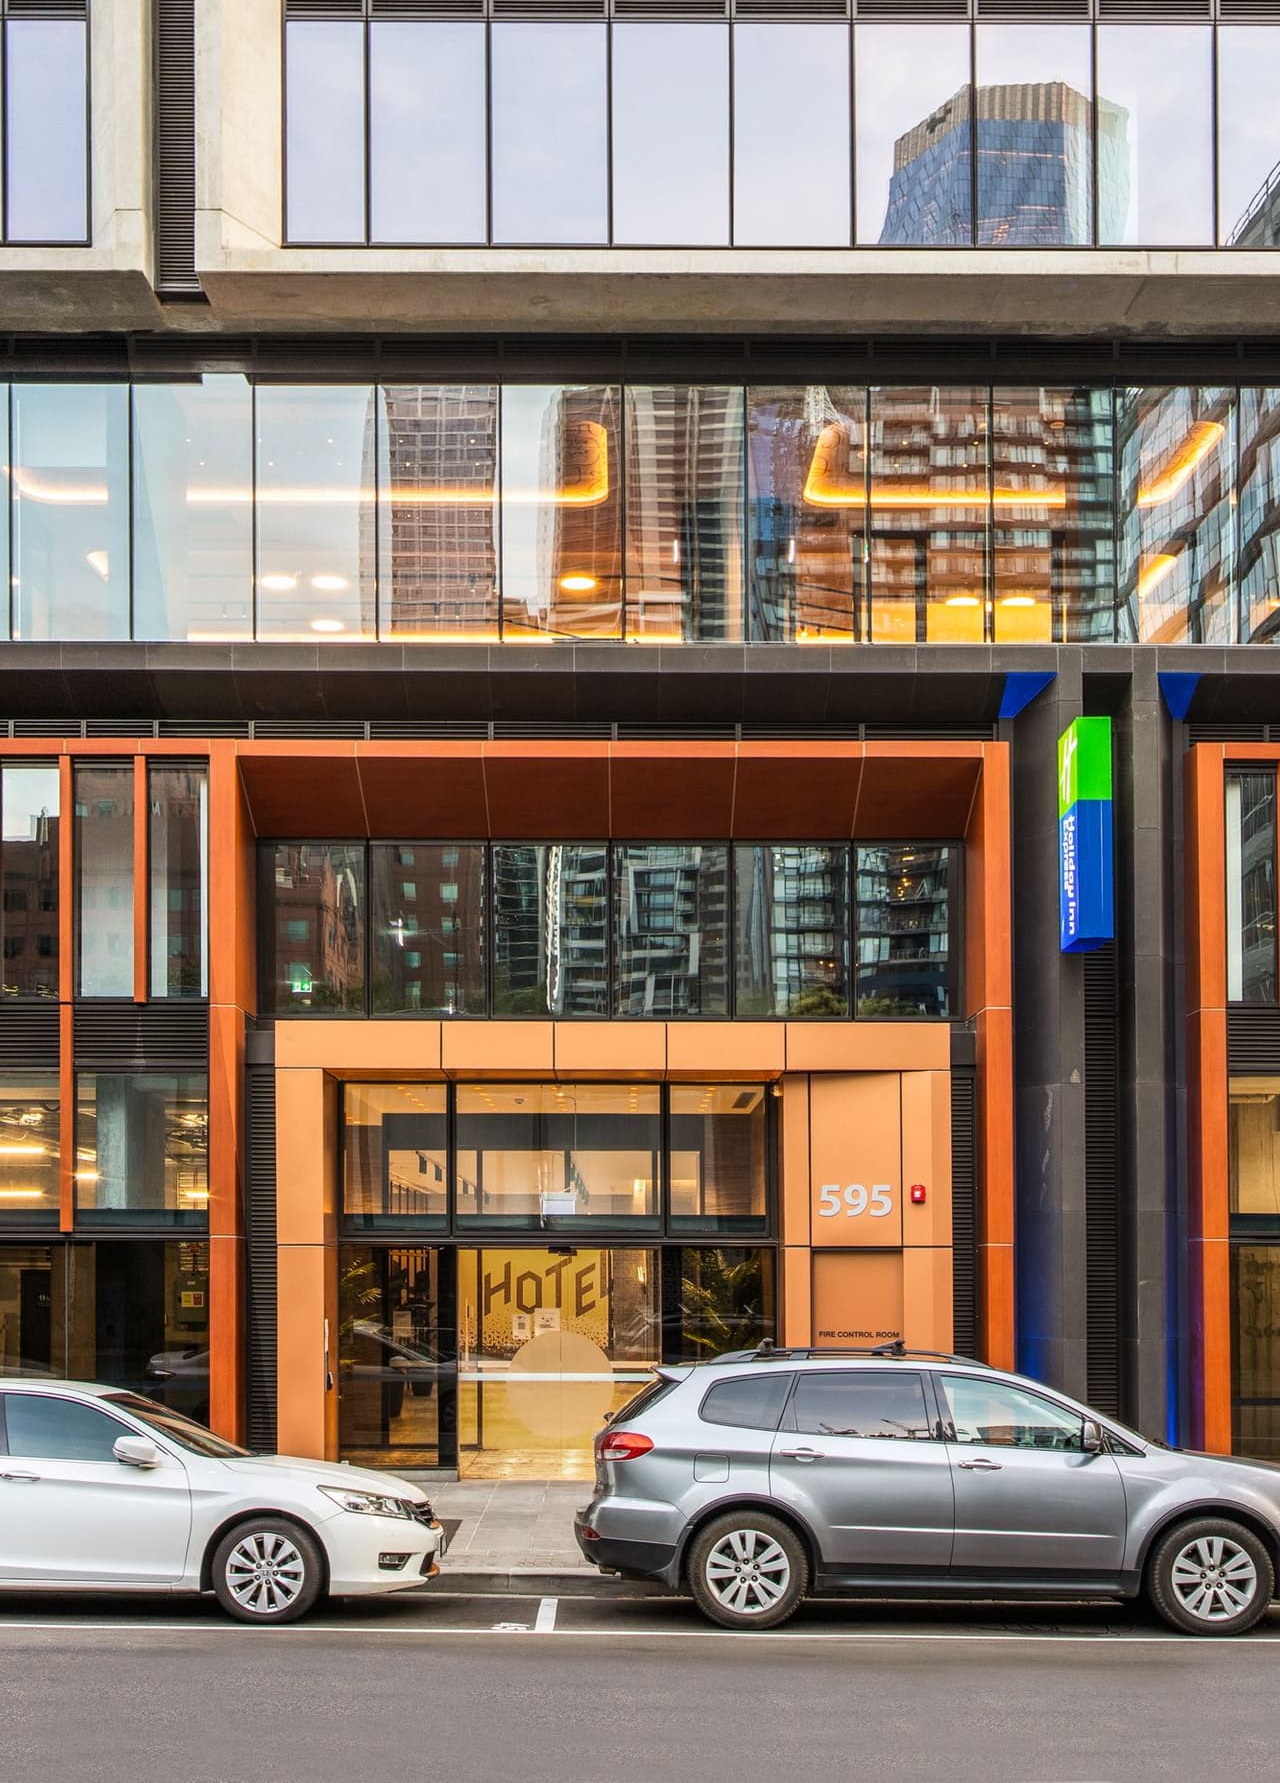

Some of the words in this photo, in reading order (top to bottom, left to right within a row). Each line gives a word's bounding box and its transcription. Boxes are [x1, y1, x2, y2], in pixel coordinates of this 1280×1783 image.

[1067, 815, 1076, 898] Holiday
[1068, 901, 1077, 935] Inn
[818, 1184, 893, 1218] 595
[876, 1331, 900, 1339] ROOM
